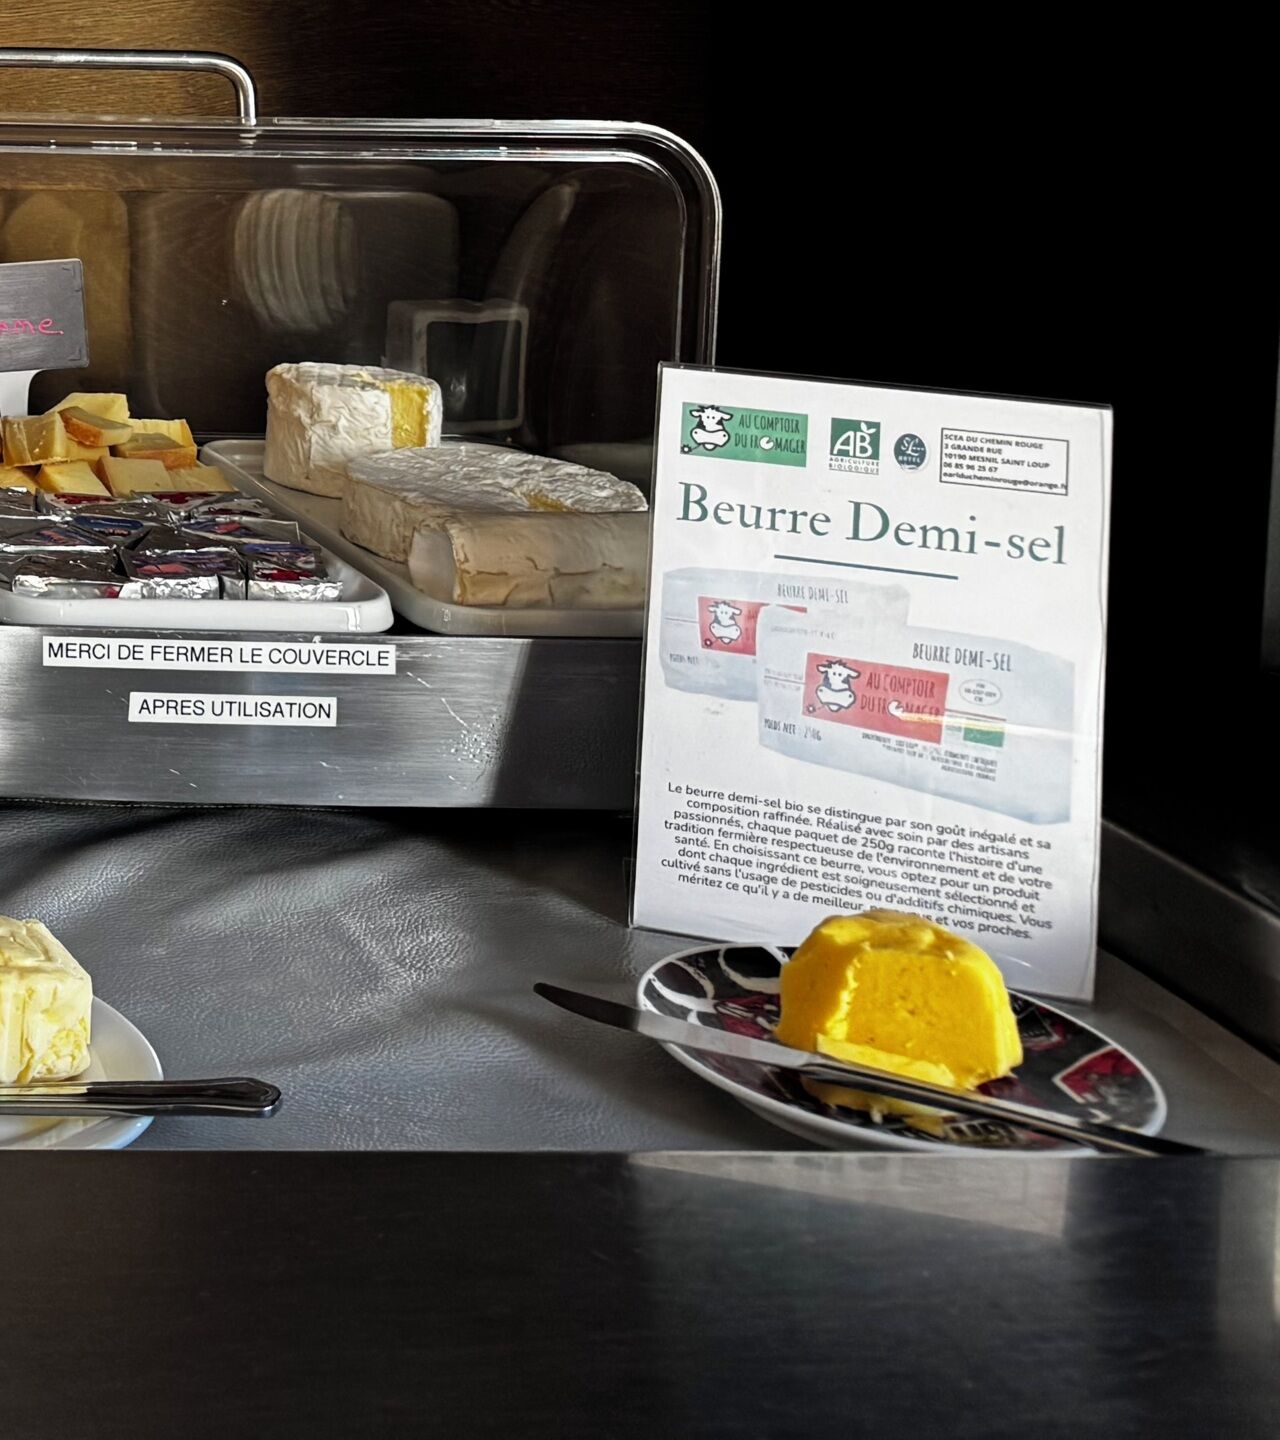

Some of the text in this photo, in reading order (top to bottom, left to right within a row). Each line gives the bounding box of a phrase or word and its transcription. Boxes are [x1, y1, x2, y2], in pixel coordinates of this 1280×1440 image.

[738, 412, 800, 434] AU COMPTOIR
[833, 431, 874, 457] AB
[676, 481, 1066, 564] Beurre Demi-sel
[48, 642, 389, 666] MERCI DE FERMER LE COUVERCLE
[912, 642, 1011, 672] BEURRE DEMI-SEL
[138, 698, 330, 718] APRES UTILISATION
[668, 781, 1051, 849] Le beurre demi-sel bio se distingue par son goût inégalé et sa
